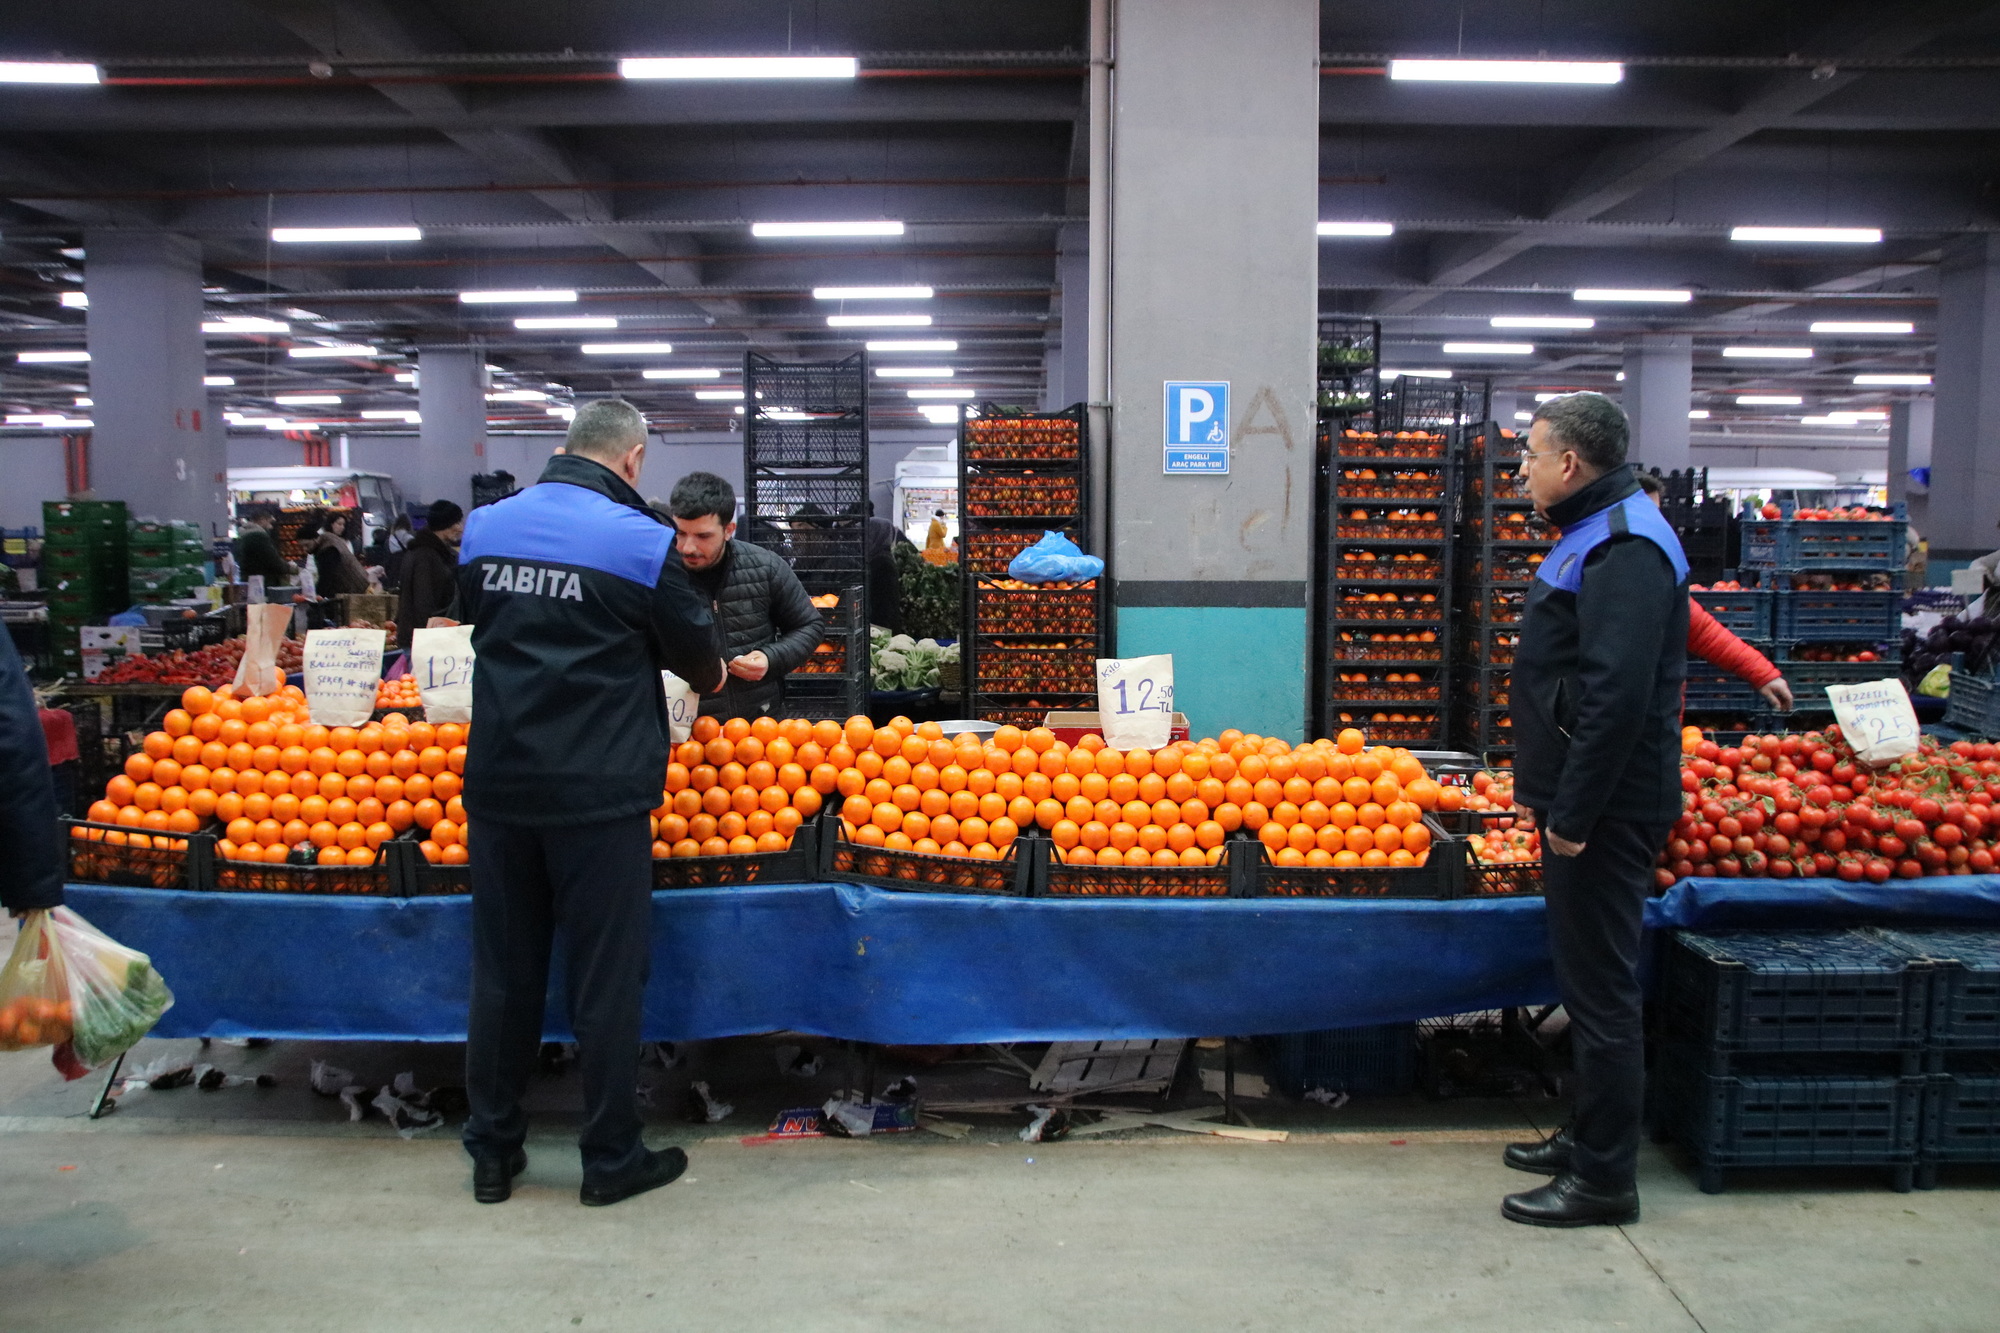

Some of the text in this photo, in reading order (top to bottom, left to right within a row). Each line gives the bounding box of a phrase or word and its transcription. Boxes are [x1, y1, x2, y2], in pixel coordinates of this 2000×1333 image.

[1179, 388, 1214, 442] P
[1207, 460, 1222, 468] YERİ
[482, 563, 584, 602] ZABITA
[1159, 701, 1172, 713] TL
[1870, 716, 1913, 744] 25
